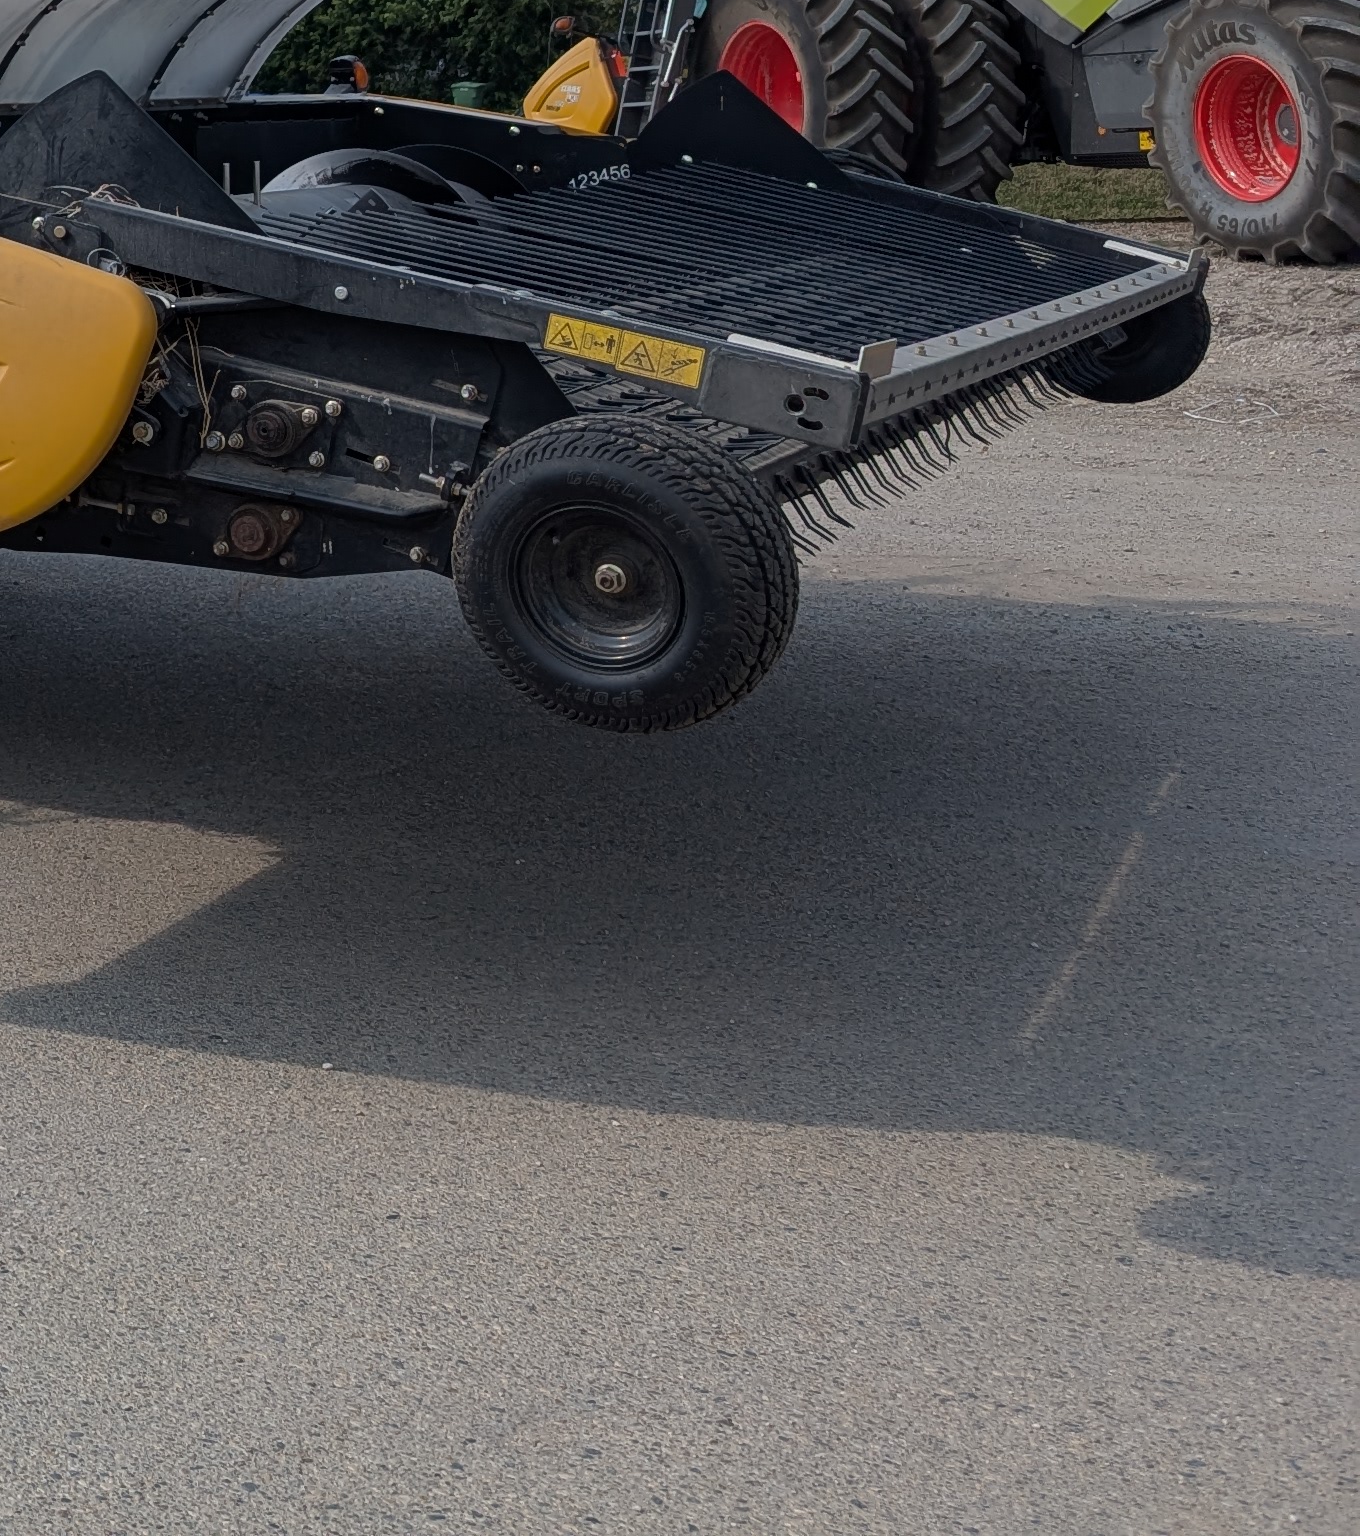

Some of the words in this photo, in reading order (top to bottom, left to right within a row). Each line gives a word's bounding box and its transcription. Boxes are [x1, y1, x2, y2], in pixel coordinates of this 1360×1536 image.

[1177, 20, 1257, 84] Mitas
[569, 163, 631, 194] 123456
[1216, 212, 1285, 238] 710/65
